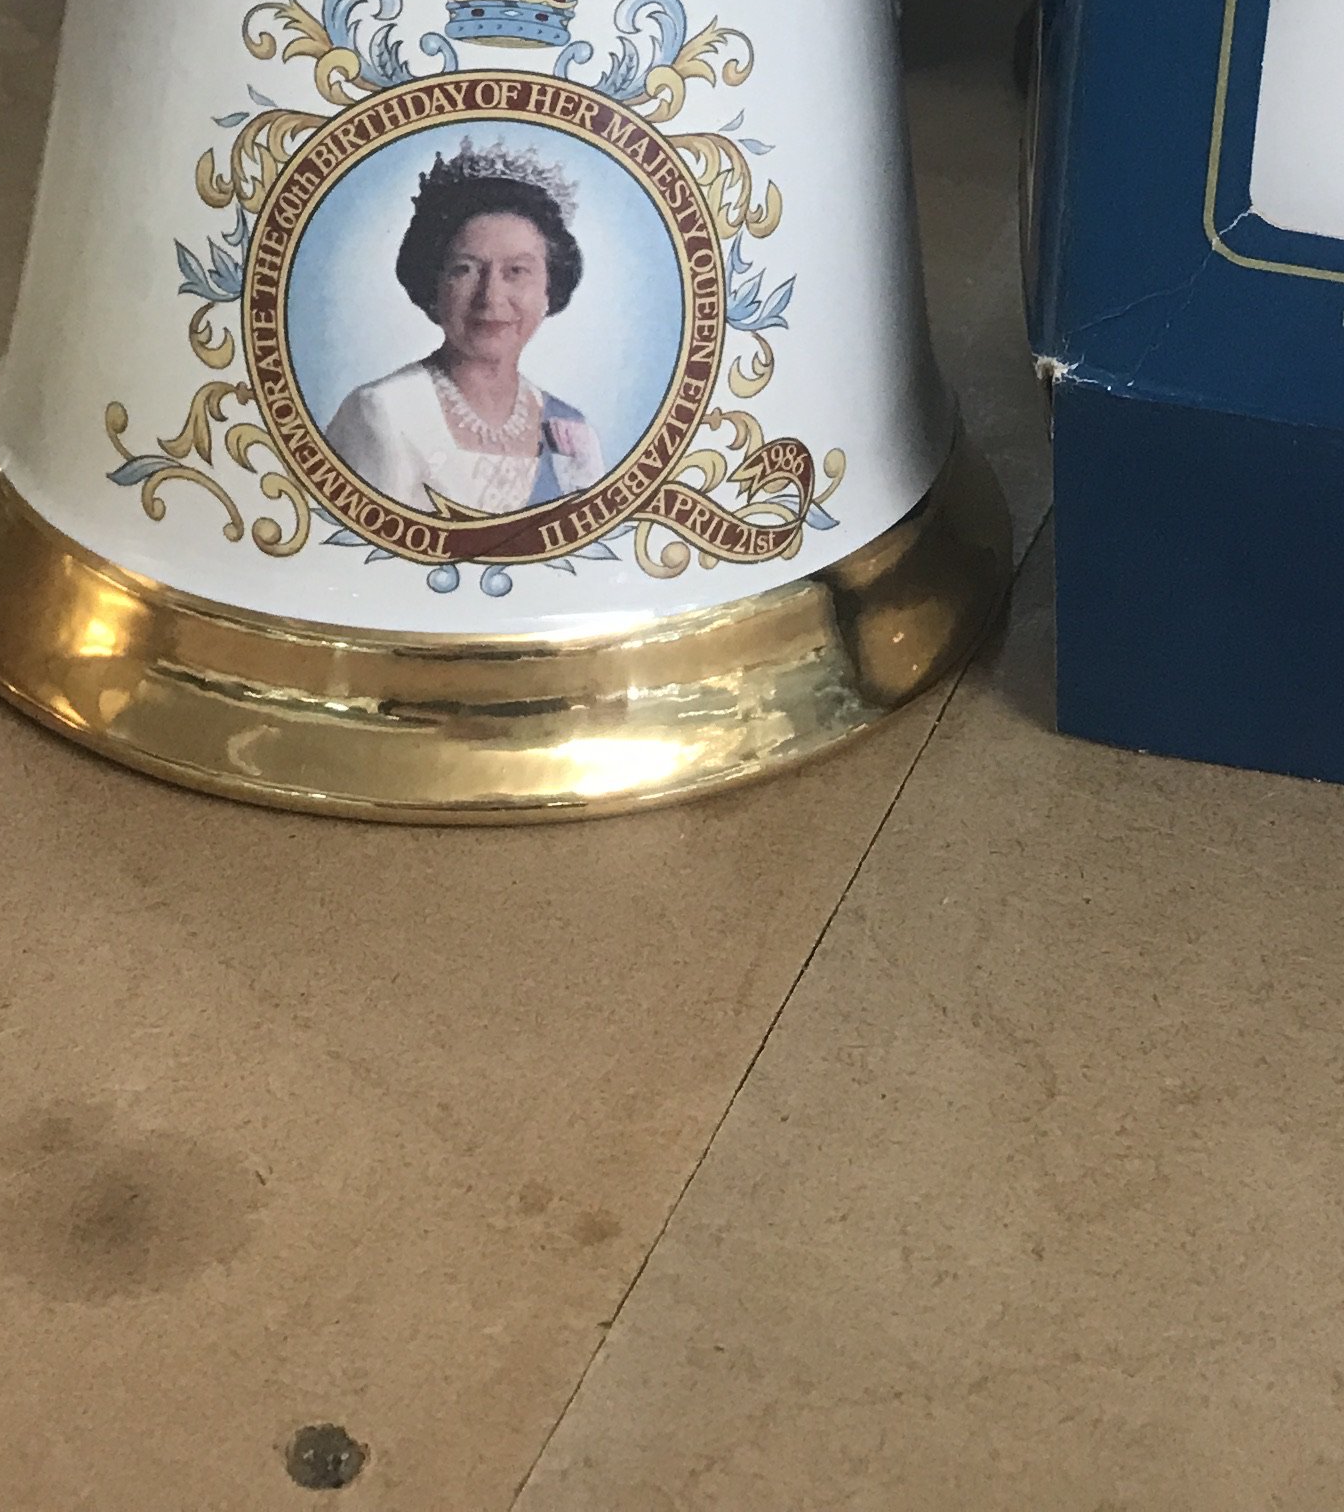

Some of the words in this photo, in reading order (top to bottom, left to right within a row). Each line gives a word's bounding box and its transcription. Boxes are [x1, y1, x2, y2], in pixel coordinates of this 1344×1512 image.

[474, 80, 522, 109] OF
[526, 84, 599, 130] HER
[310, 83, 469, 178] BIRTHDAY
[274, 157, 322, 229] 60th
[601, 112, 708, 242] MAJESTY
[253, 226, 288, 295] THE
[689, 247, 720, 364] QUEEN
[252, 310, 404, 542] COMMEMORATE
[568, 376, 707, 538] ELIZABETH
[761, 442, 808, 477] 1986
[406, 524, 452, 558] TO
[647, 486, 733, 550] APRIL
[732, 528, 778, 556] 21st
